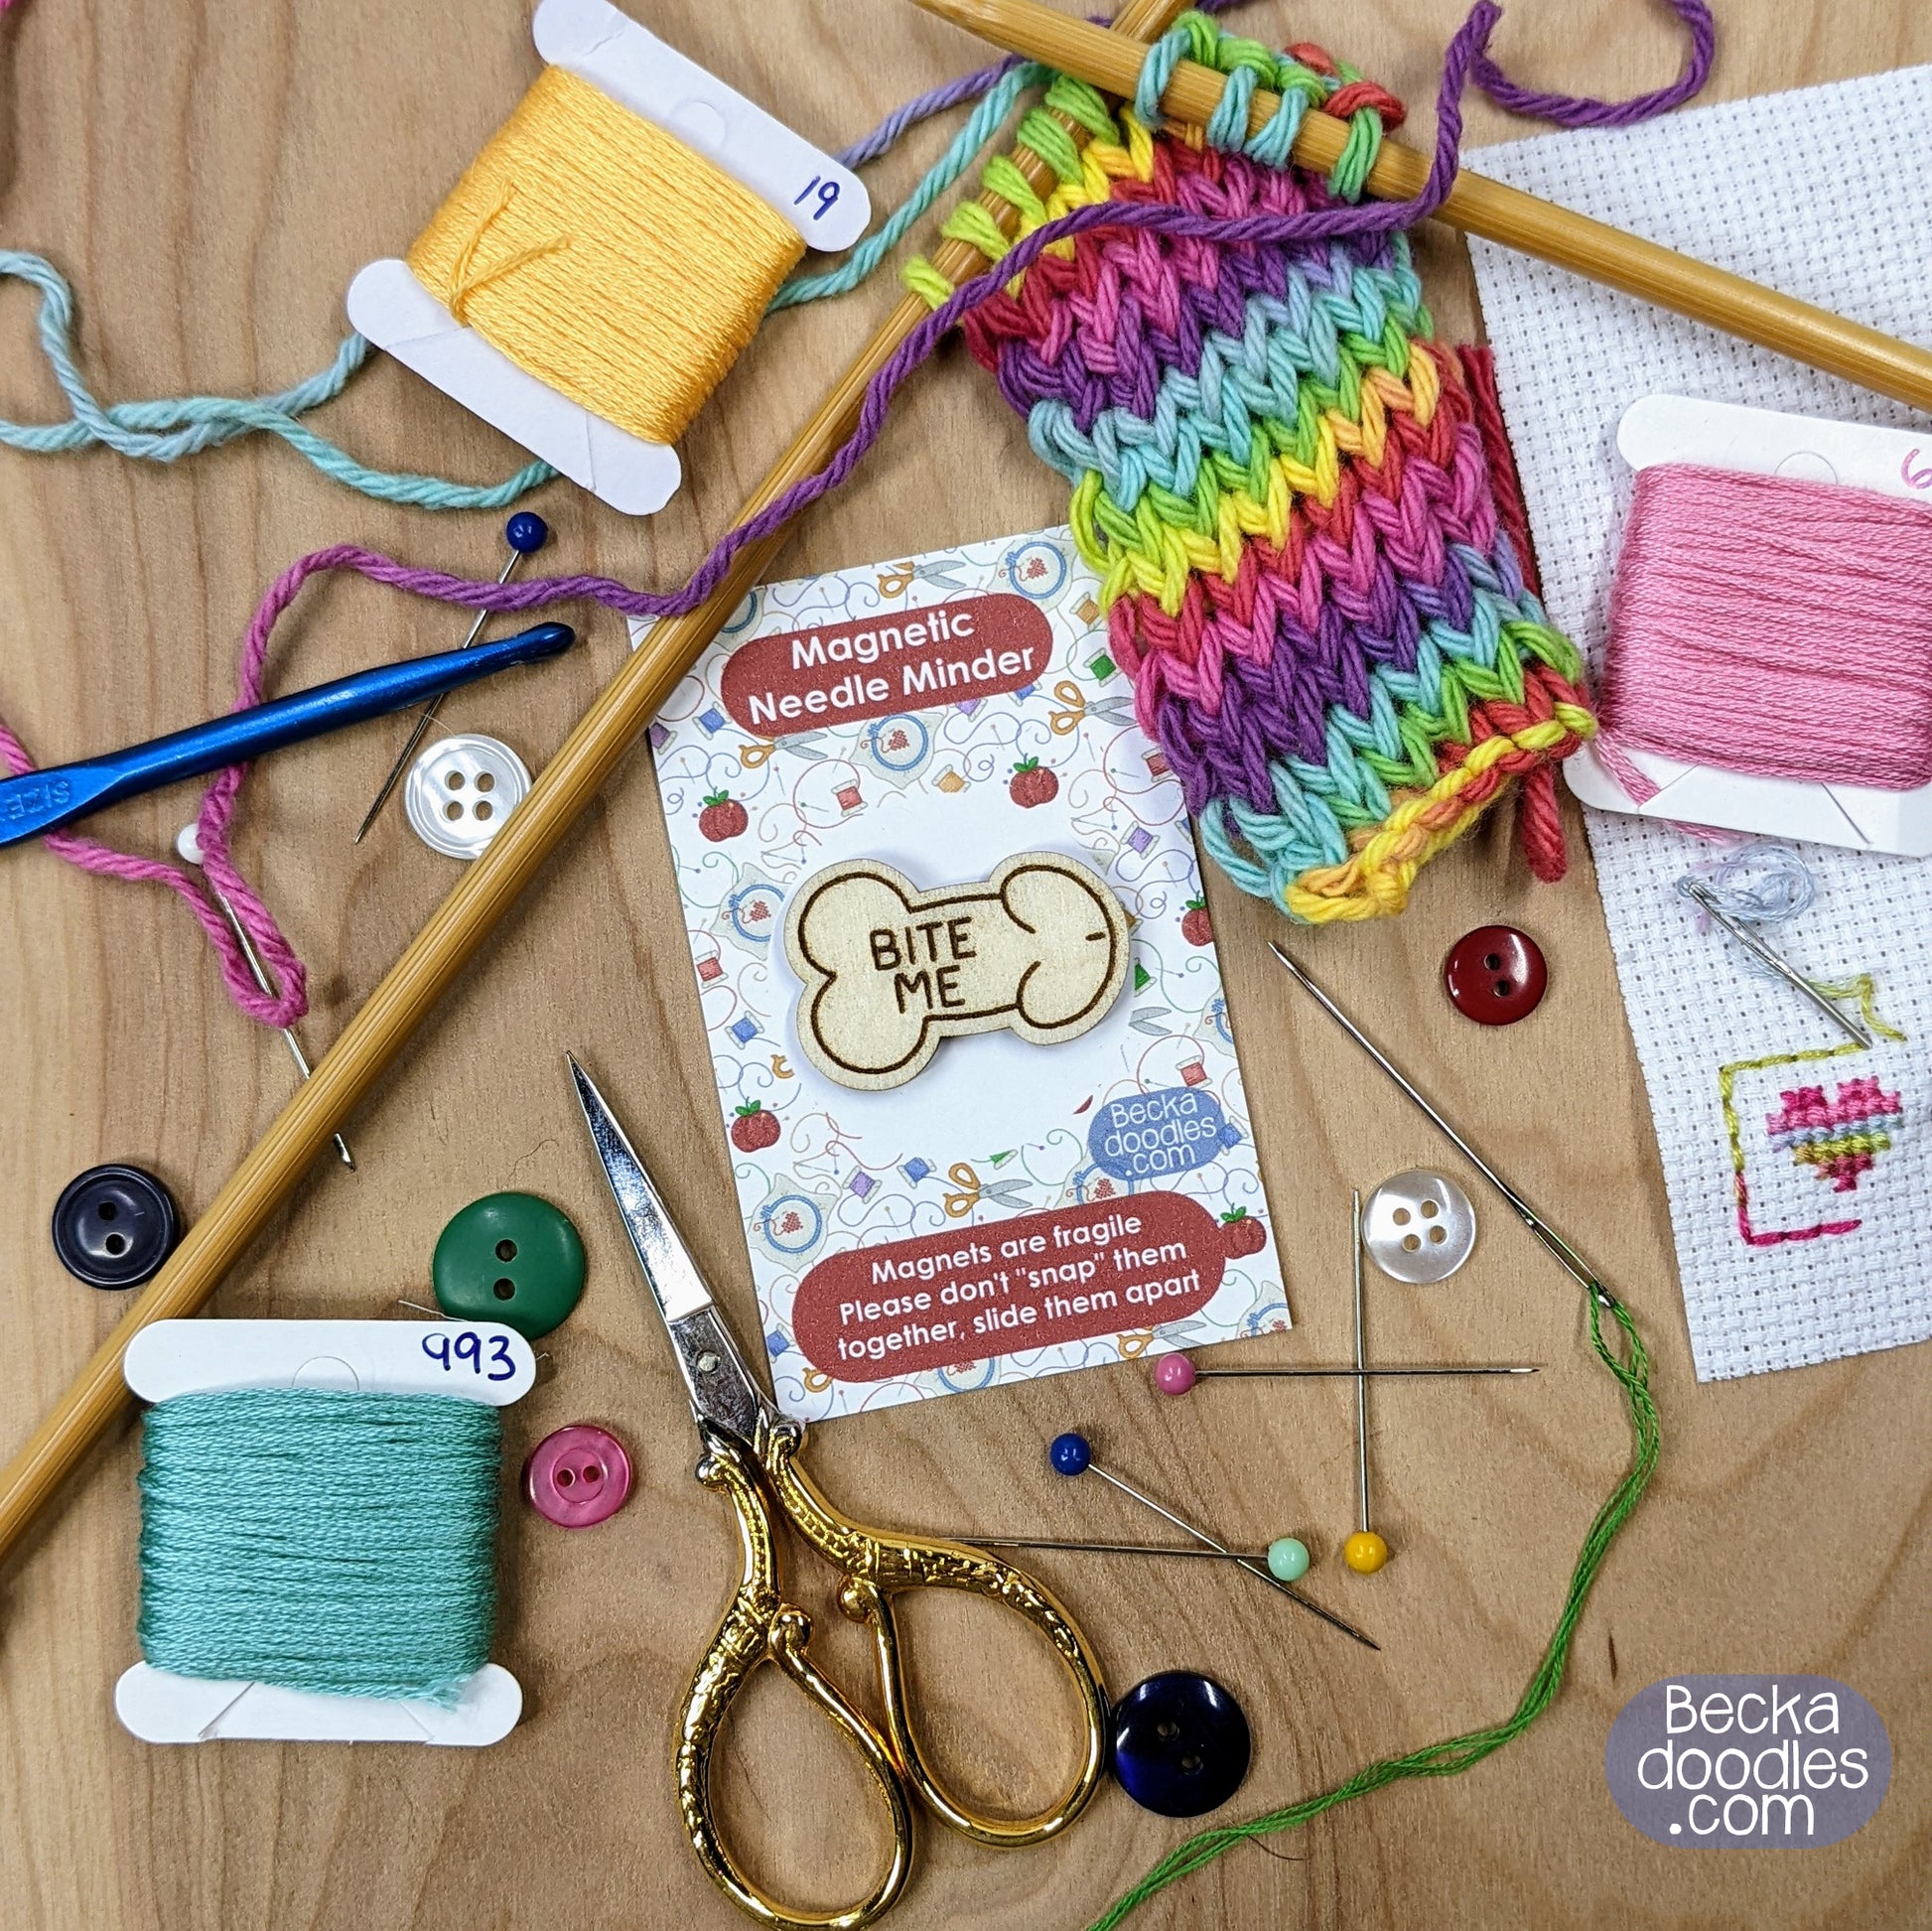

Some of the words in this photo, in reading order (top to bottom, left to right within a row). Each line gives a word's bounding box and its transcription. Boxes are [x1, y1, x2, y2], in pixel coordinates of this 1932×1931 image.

[793, 175, 841, 220] 19
[792, 610, 975, 669] Magnetic
[748, 677, 890, 725] Needle
[901, 646, 1035, 696] Minder
[870, 915, 977, 971] BITE
[894, 964, 966, 1014] ME
[1104, 1116, 1217, 1158] doodles
[1110, 1092, 1197, 1129] Becka
[872, 1242, 992, 1285] Magnets
[1000, 1234, 1047, 1259] are
[1053, 1213, 1143, 1246] fragile
[840, 1292, 931, 1326] Please
[940, 1271, 1010, 1306] don't
[1016, 1251, 1105, 1285] "snap"
[1113, 1242, 1187, 1272] them
[838, 1320, 965, 1360] together,
[973, 1304, 1037, 1334] slide
[1043, 1290, 1118, 1320] them
[1125, 1268, 1201, 1307] apart
[421, 1330, 516, 1381] 993
